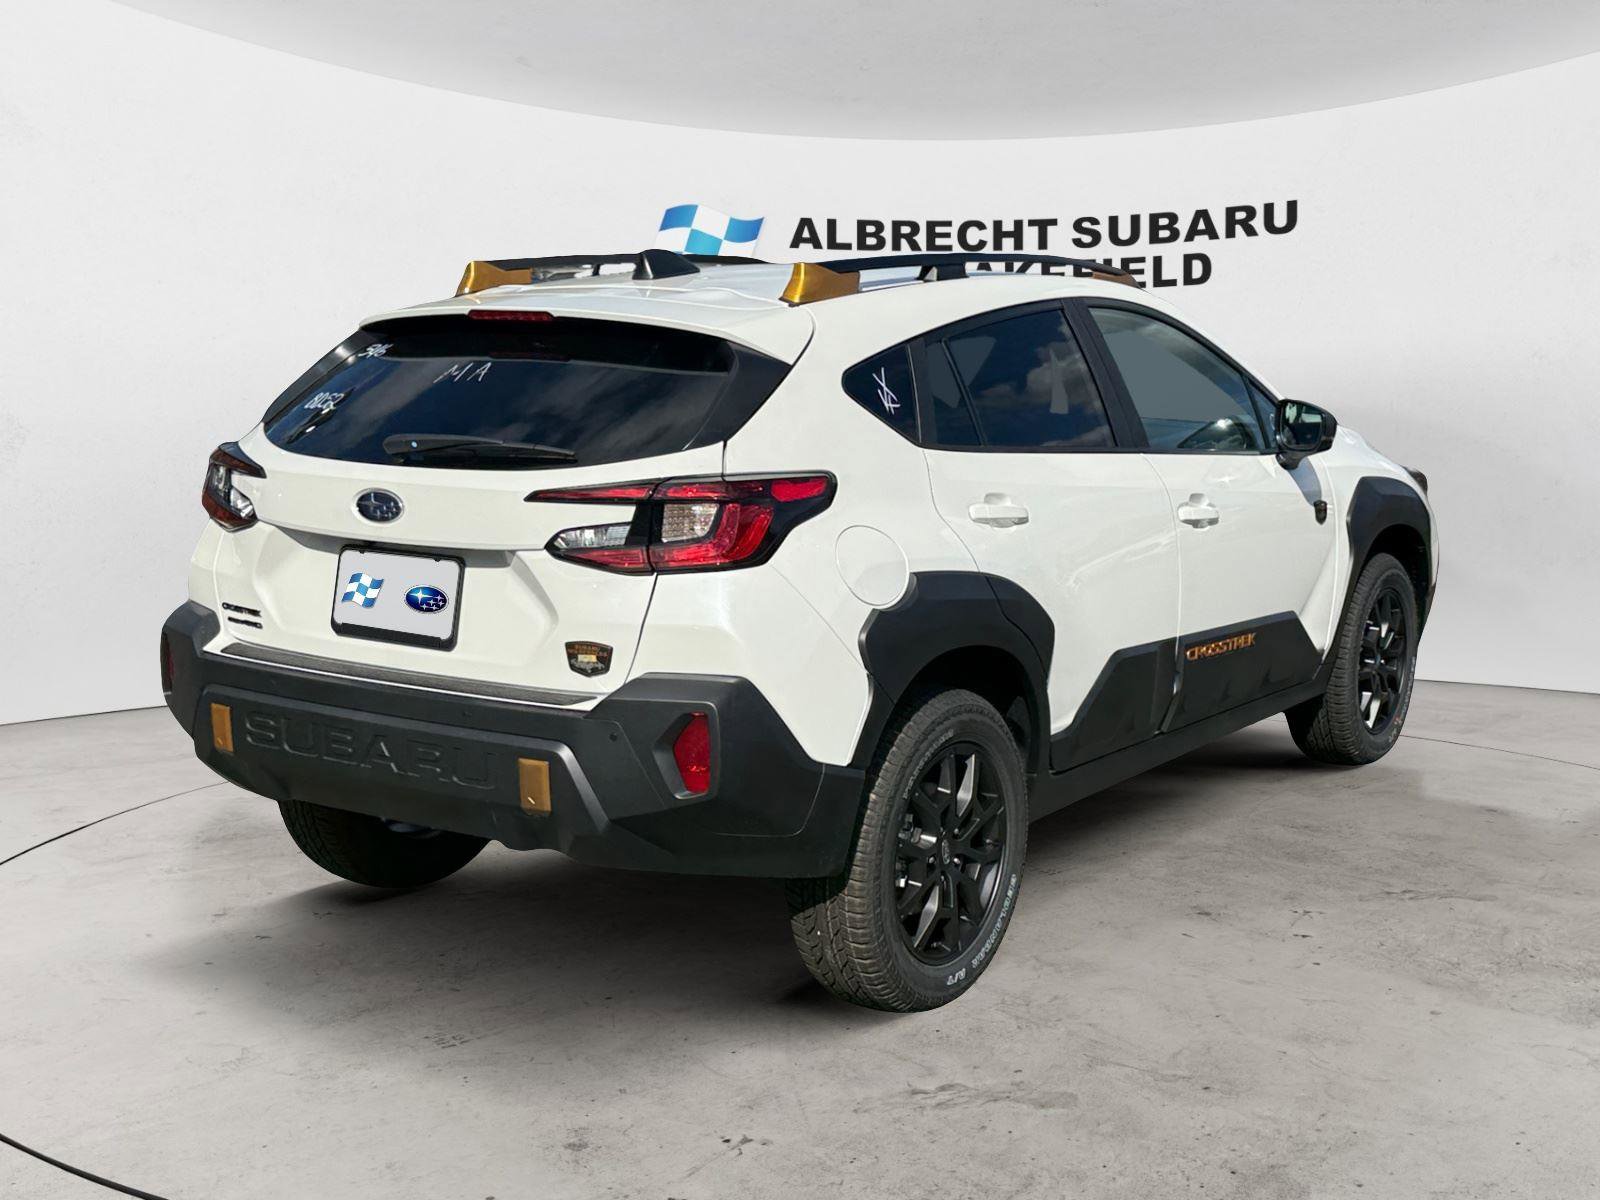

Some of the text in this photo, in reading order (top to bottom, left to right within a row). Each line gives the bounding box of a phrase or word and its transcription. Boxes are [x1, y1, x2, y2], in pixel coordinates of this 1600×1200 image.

[789, 200, 1299, 252] ALBRECHT SUBARU
[244, 710, 499, 790] SUBARU
